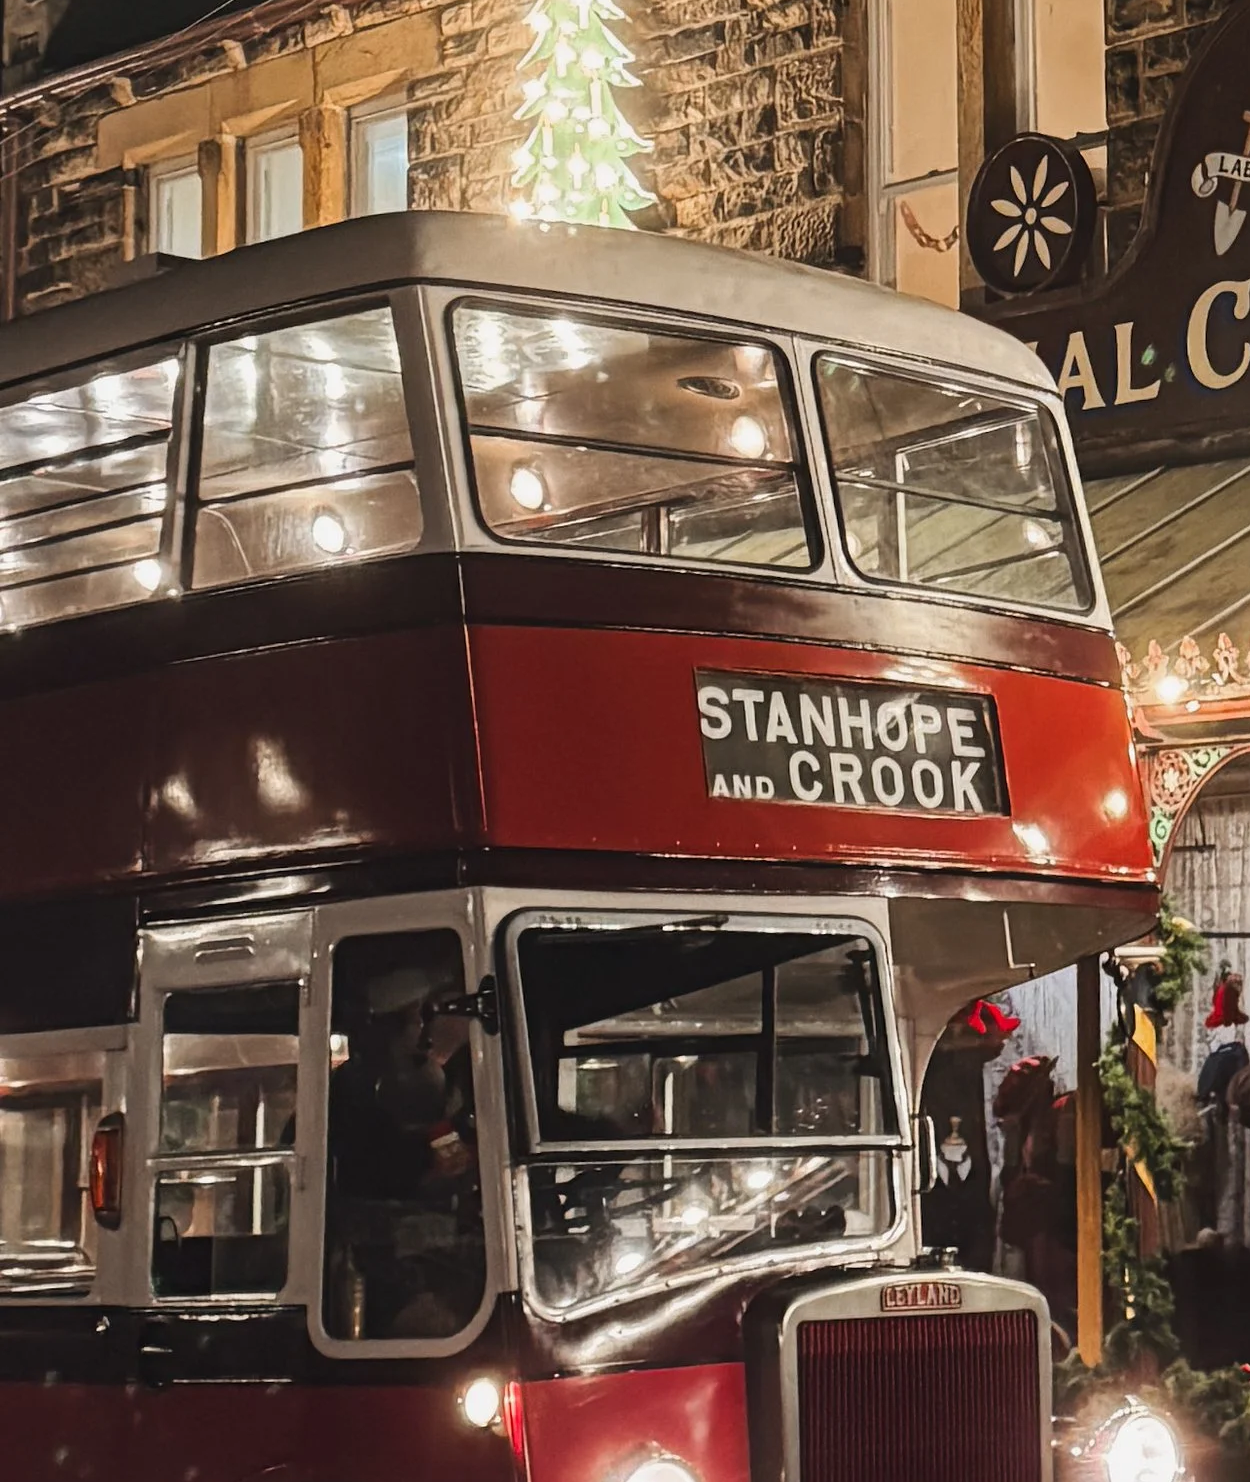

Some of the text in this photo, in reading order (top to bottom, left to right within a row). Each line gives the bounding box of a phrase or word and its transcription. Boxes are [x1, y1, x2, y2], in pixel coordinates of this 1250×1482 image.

[1025, 321, 1161, 411] AL
[697, 685, 987, 758] STANHOPE
[712, 749, 985, 813] AND CROOK
[886, 1282, 960, 1307] LEYLAND
